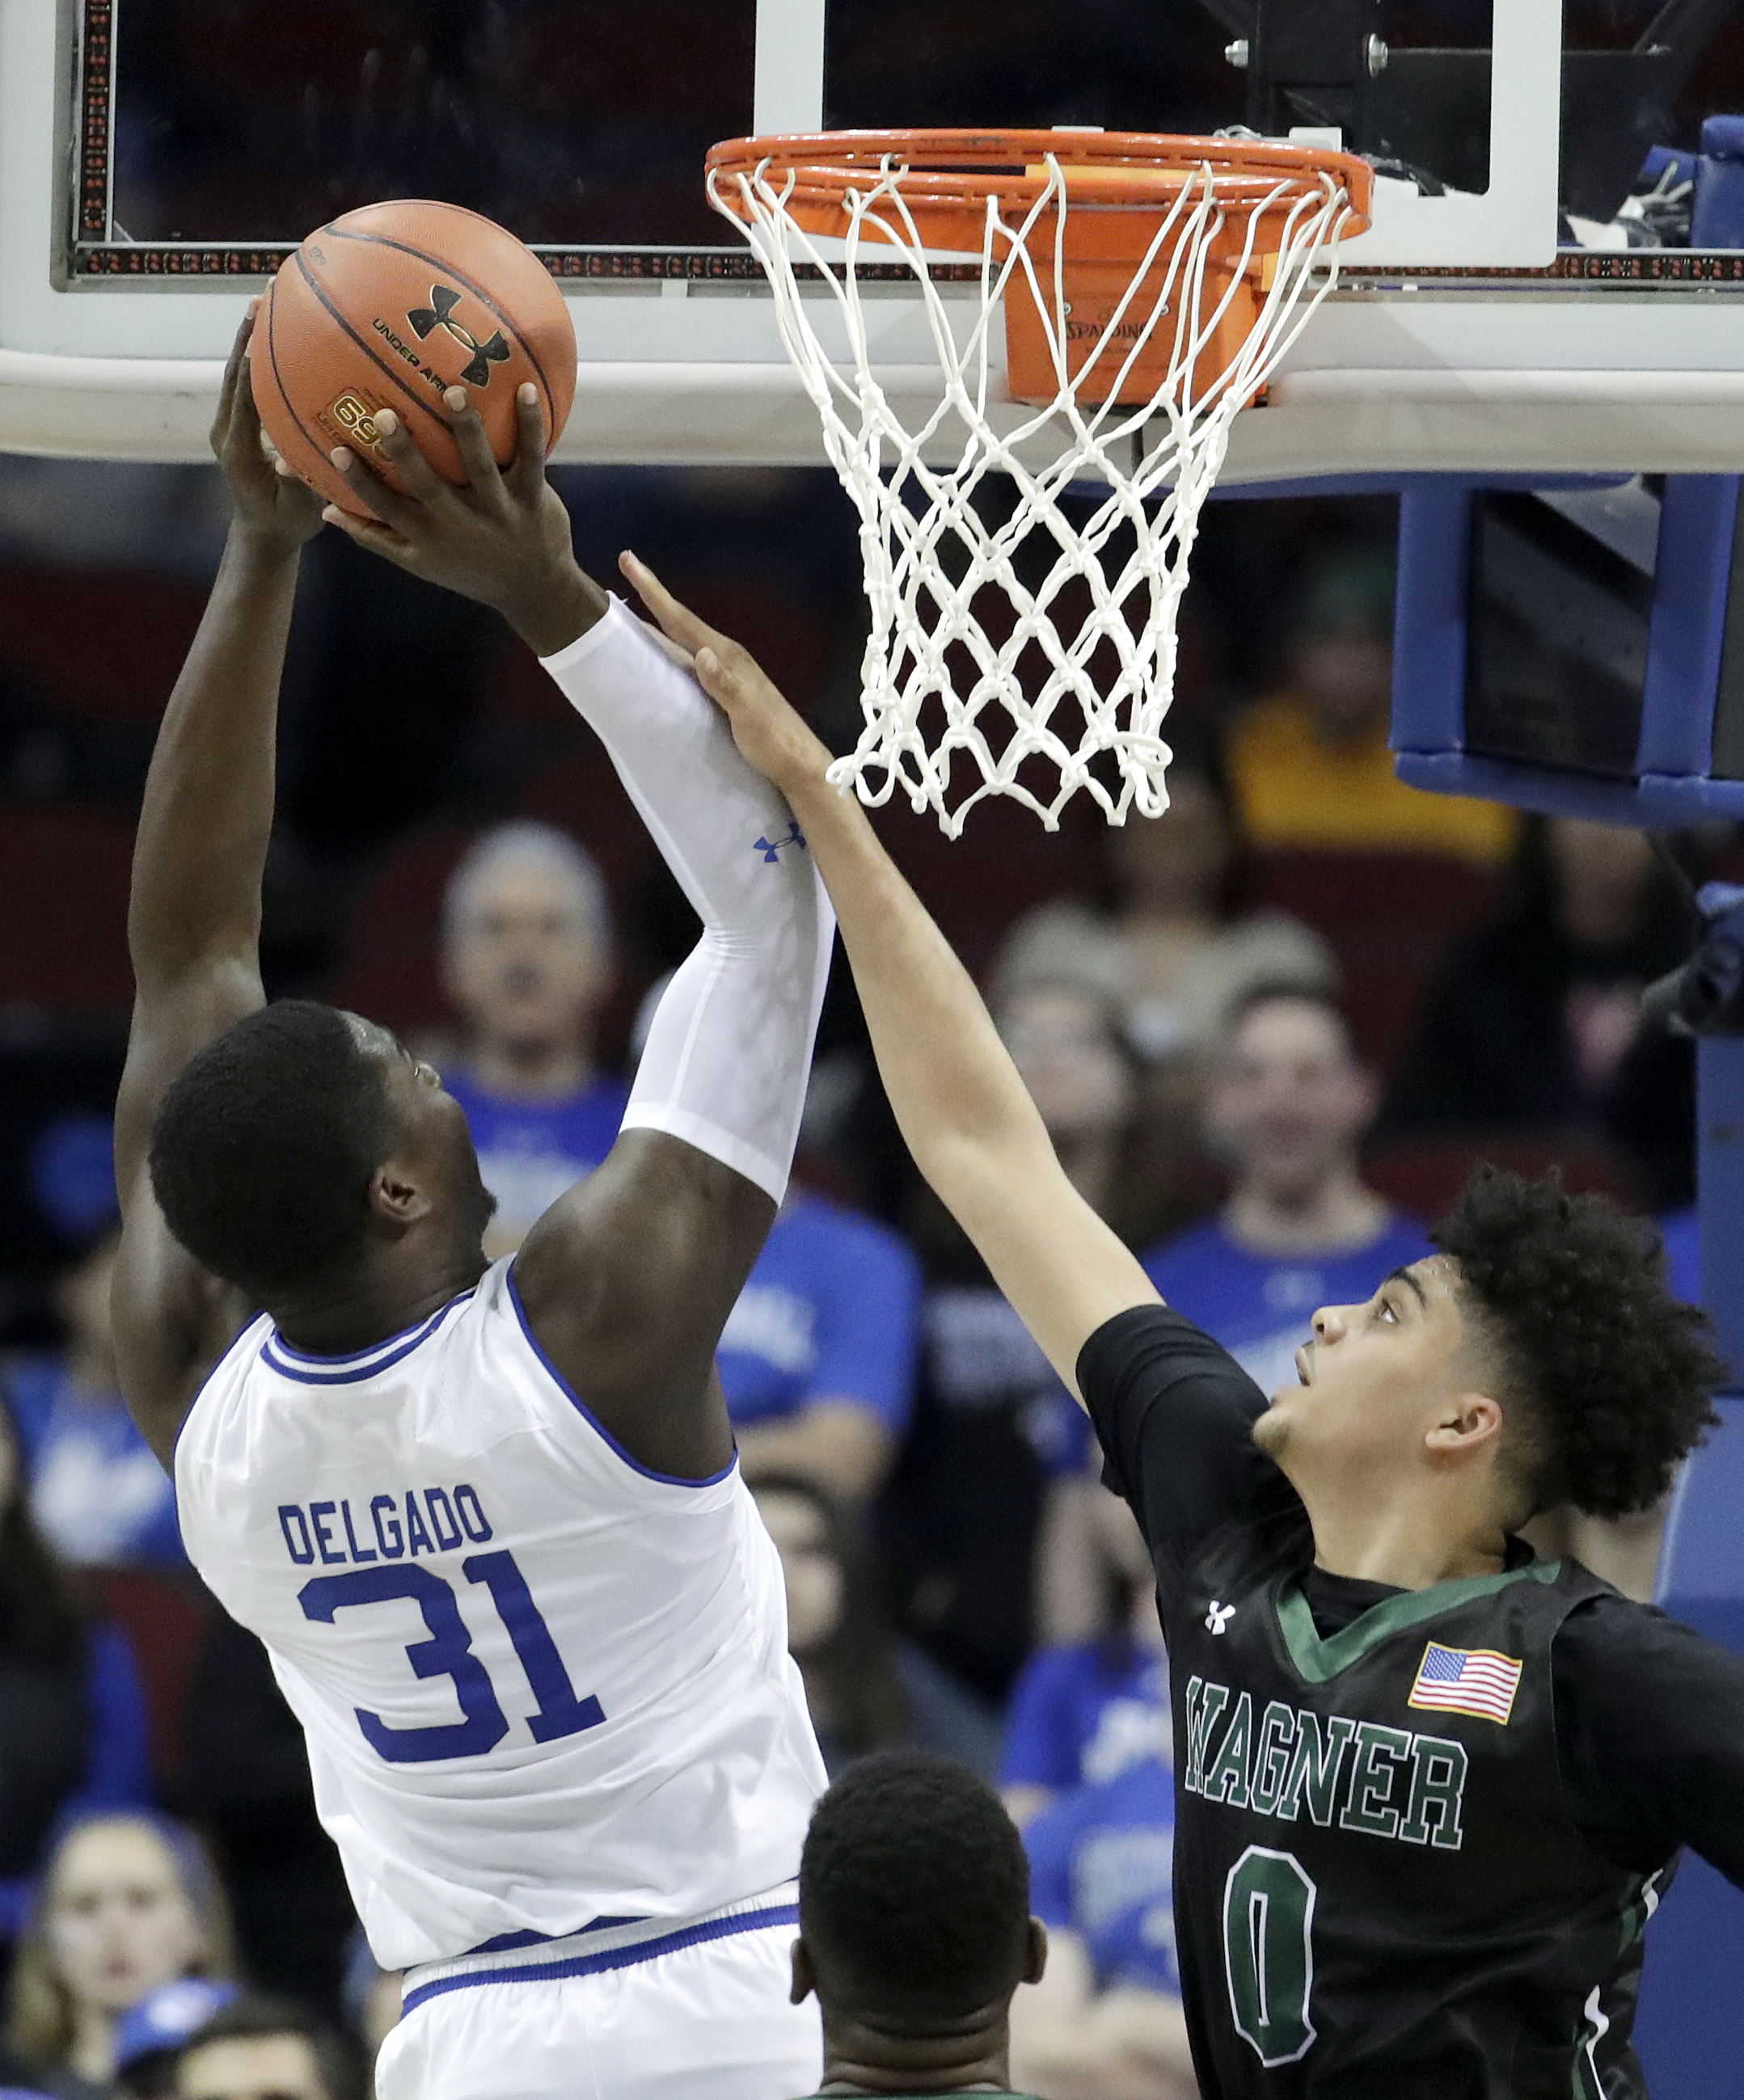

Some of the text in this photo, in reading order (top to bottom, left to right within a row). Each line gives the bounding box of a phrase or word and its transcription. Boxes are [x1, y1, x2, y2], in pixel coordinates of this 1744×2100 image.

[373, 318, 420, 366] UNDER
[278, 1484, 493, 1564] DELGADO
[298, 1550, 606, 1762] 31
[1184, 1675, 1468, 1850] WAGNER
[1223, 1845, 1316, 2068] 0
